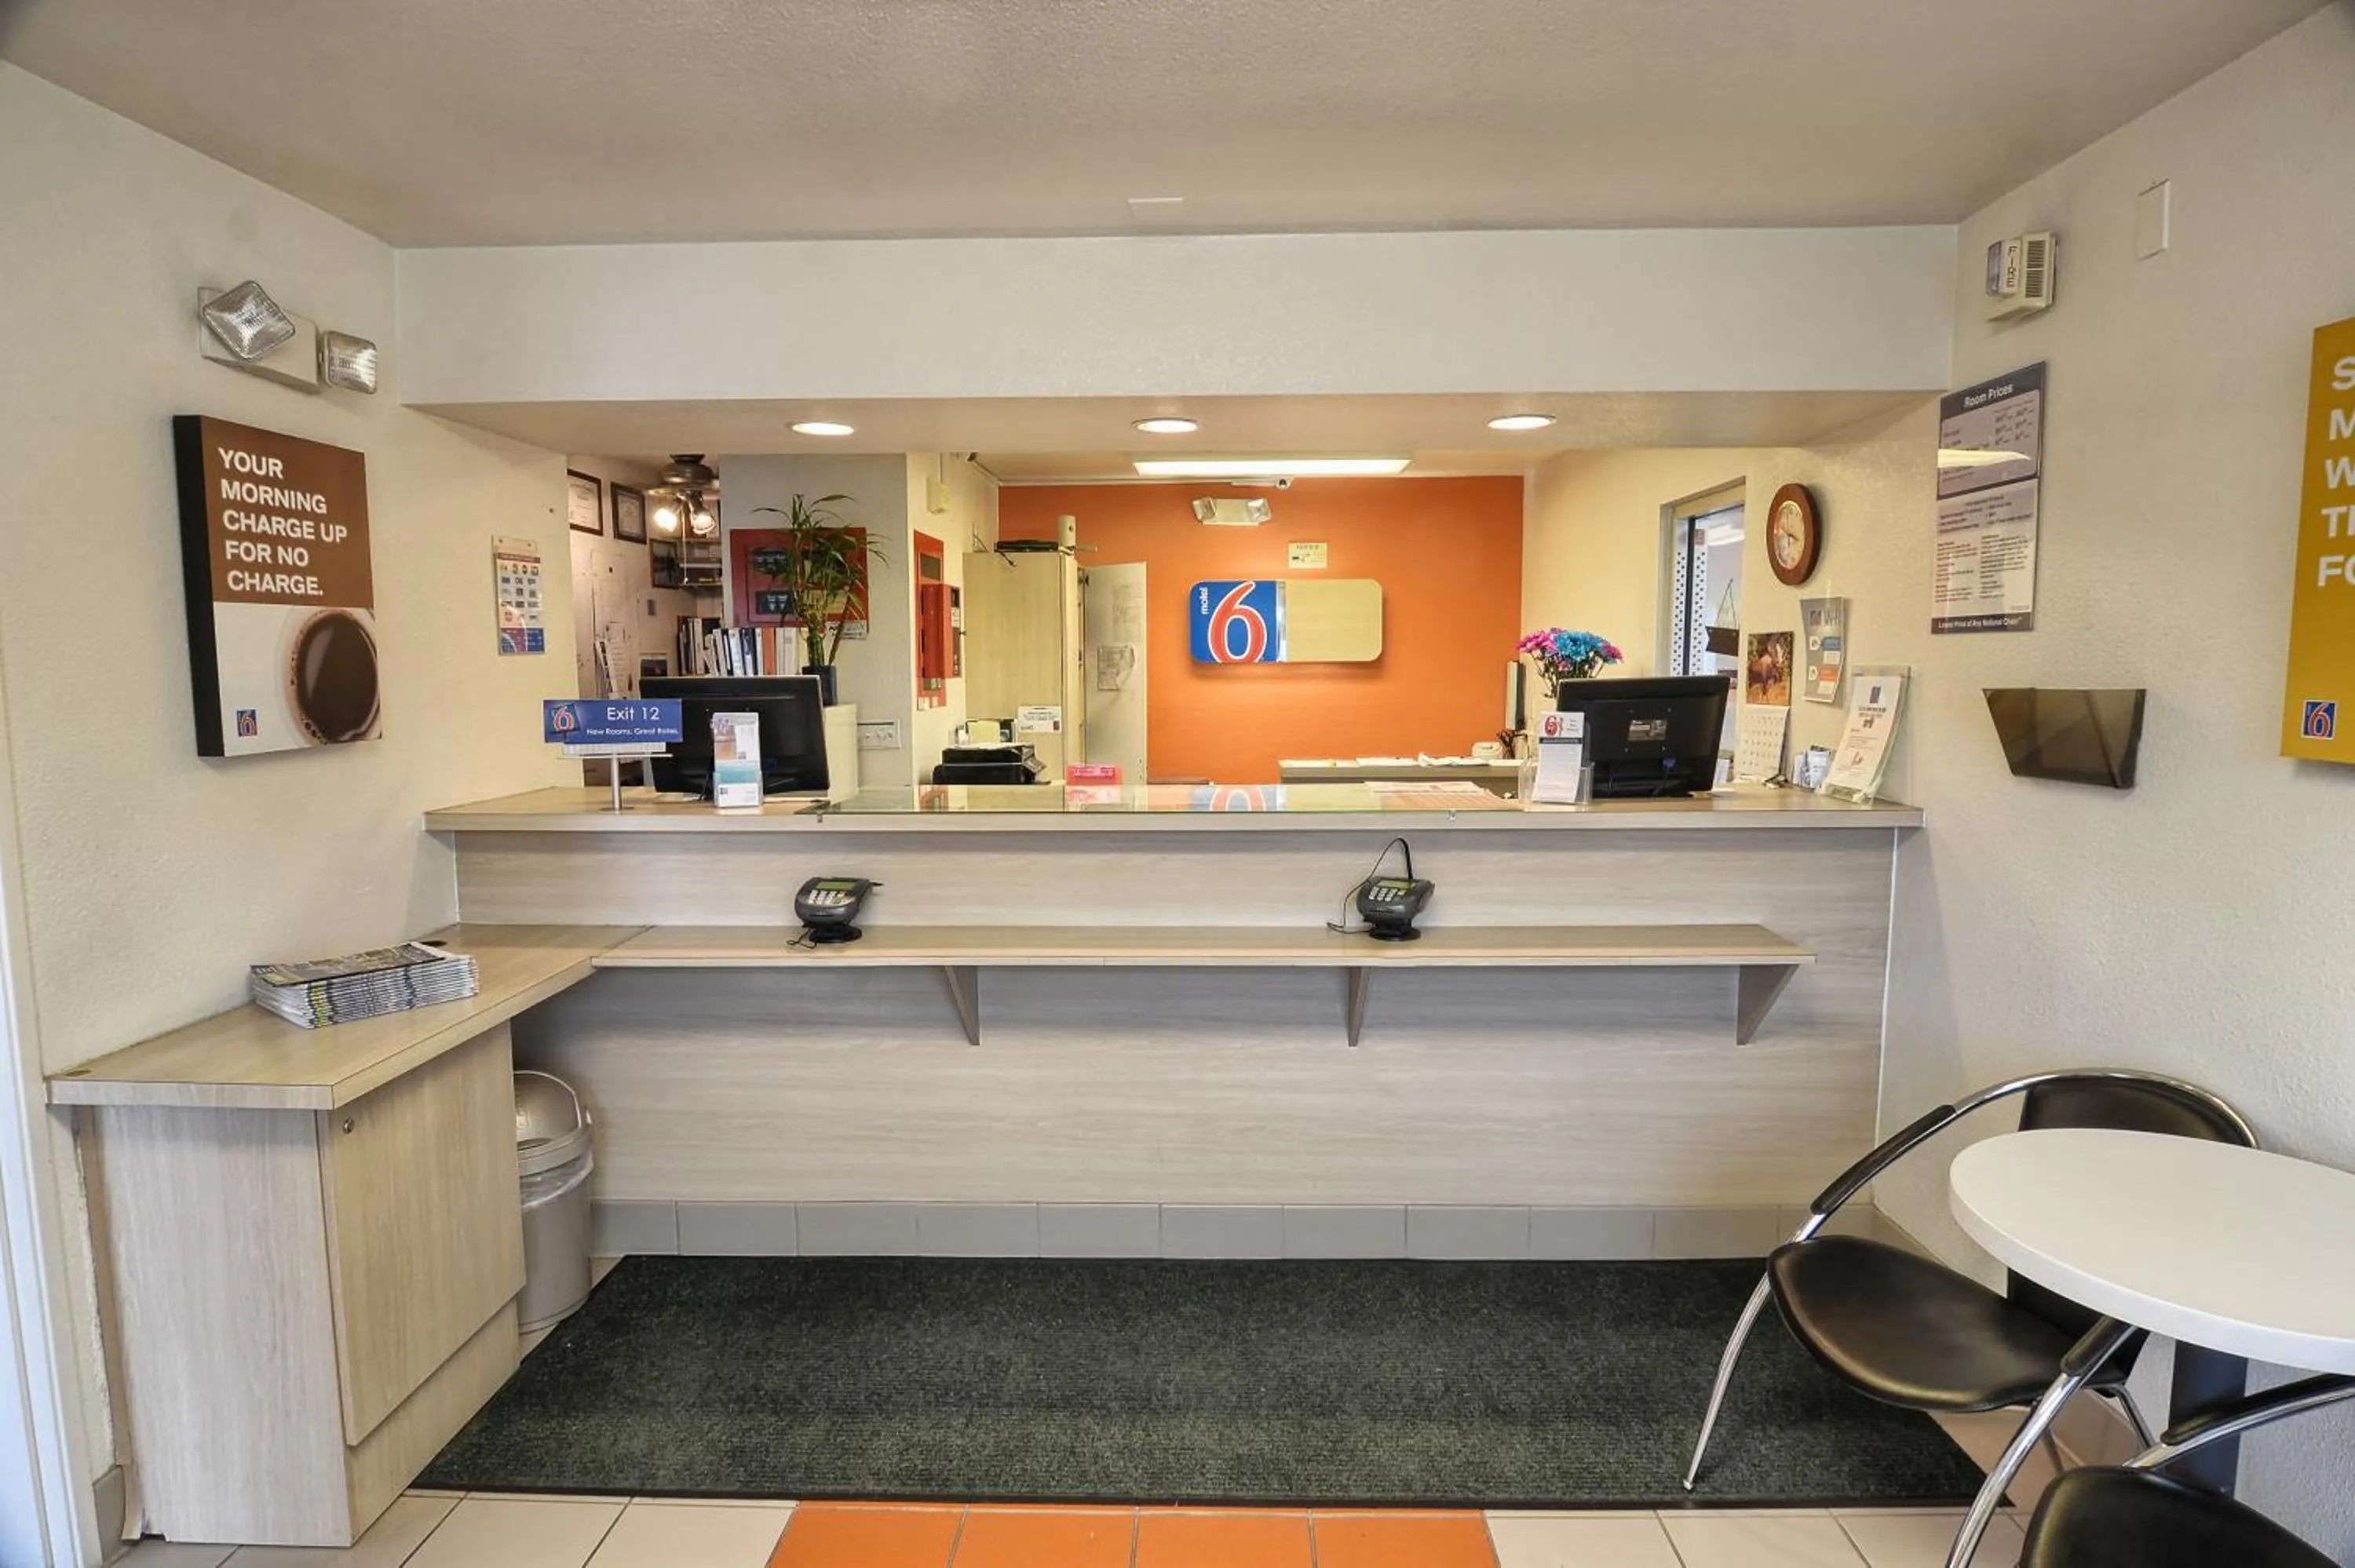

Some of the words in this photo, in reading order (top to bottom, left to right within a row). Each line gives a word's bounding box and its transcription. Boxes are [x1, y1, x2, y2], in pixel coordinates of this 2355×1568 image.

[2006, 246, 2018, 288] FIRE
[1964, 393, 1987, 407] Room
[1988, 385, 2014, 399] Prices
[217, 447, 283, 480] YOUR
[221, 479, 327, 514] MORNING
[223, 509, 316, 540] CHARGE
[319, 523, 347, 543] UP
[225, 540, 272, 564] FOR
[277, 545, 309, 567] NO
[227, 570, 323, 596] CHARGE.
[1199, 587, 1209, 614] motel
[1208, 580, 1268, 663] 6
[607, 706, 634, 721] Exit
[642, 706, 660, 720] 12
[2309, 702, 2331, 738] 6
[633, 727, 655, 735] Great
